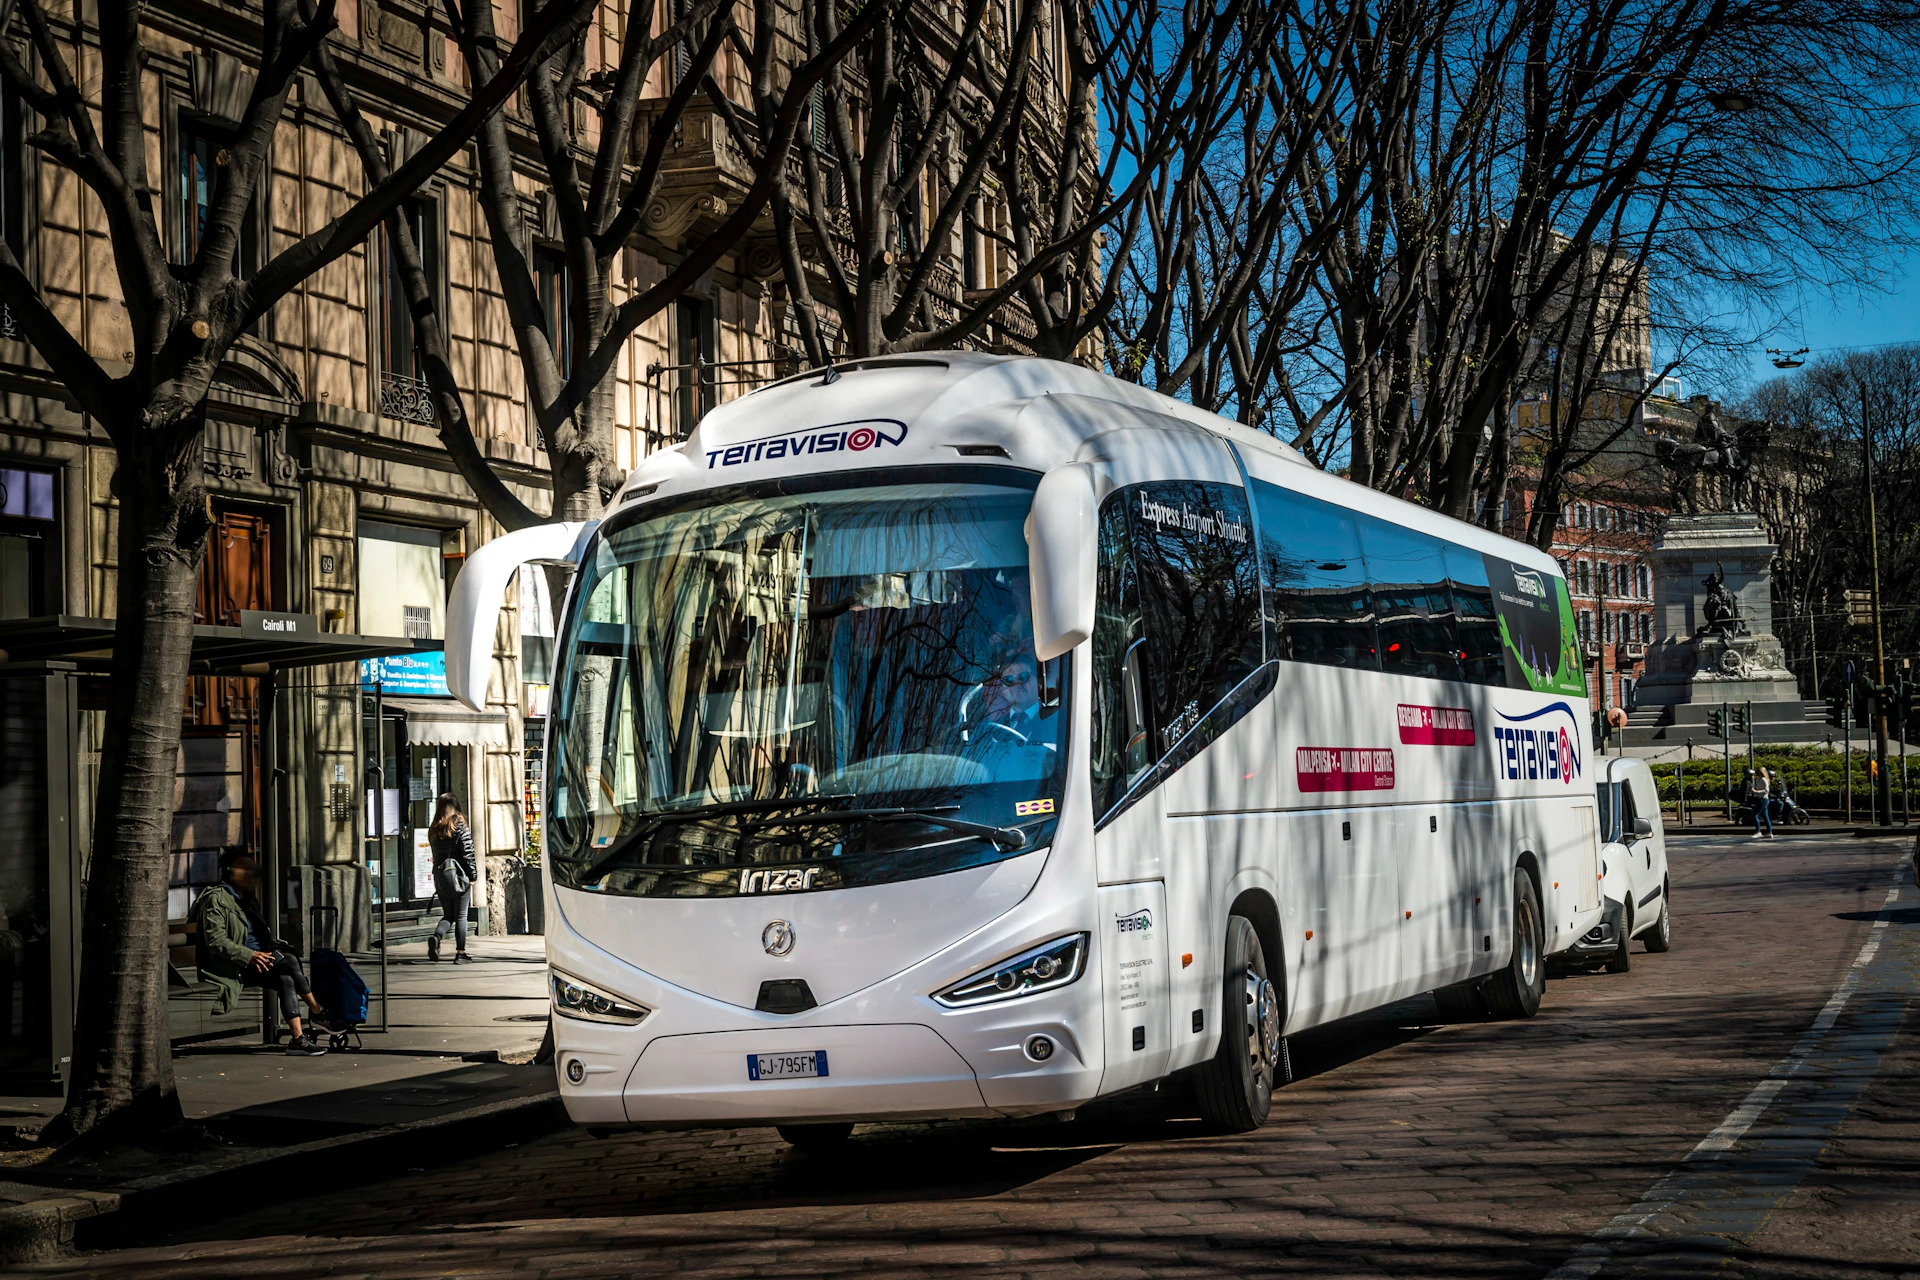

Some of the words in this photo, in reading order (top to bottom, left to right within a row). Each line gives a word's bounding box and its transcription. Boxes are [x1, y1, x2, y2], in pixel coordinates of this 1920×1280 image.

[1140, 490, 1180, 532] Express
[1182, 502, 1215, 542] Airport
[1215, 510, 1247, 543] Shuttle
[321, 557, 333, 571] 69
[262, 619, 284, 632] Cairoli
[286, 620, 297, 632] M1
[385, 656, 402, 667] Punto
[403, 656, 413, 667] Blu
[1397, 706, 1423, 728] BERGAMO
[1431, 709, 1447, 729] MILAN
[1447, 710, 1457, 729] CITY
[1456, 710, 1474, 730] CENTRE
[1297, 750, 1332, 773] MALPENSA
[1340, 750, 1360, 773] MILAN
[1360, 750, 1372, 773] CITY
[1373, 751, 1393, 773] CENTRE
[739, 867, 820, 893] Irizar
